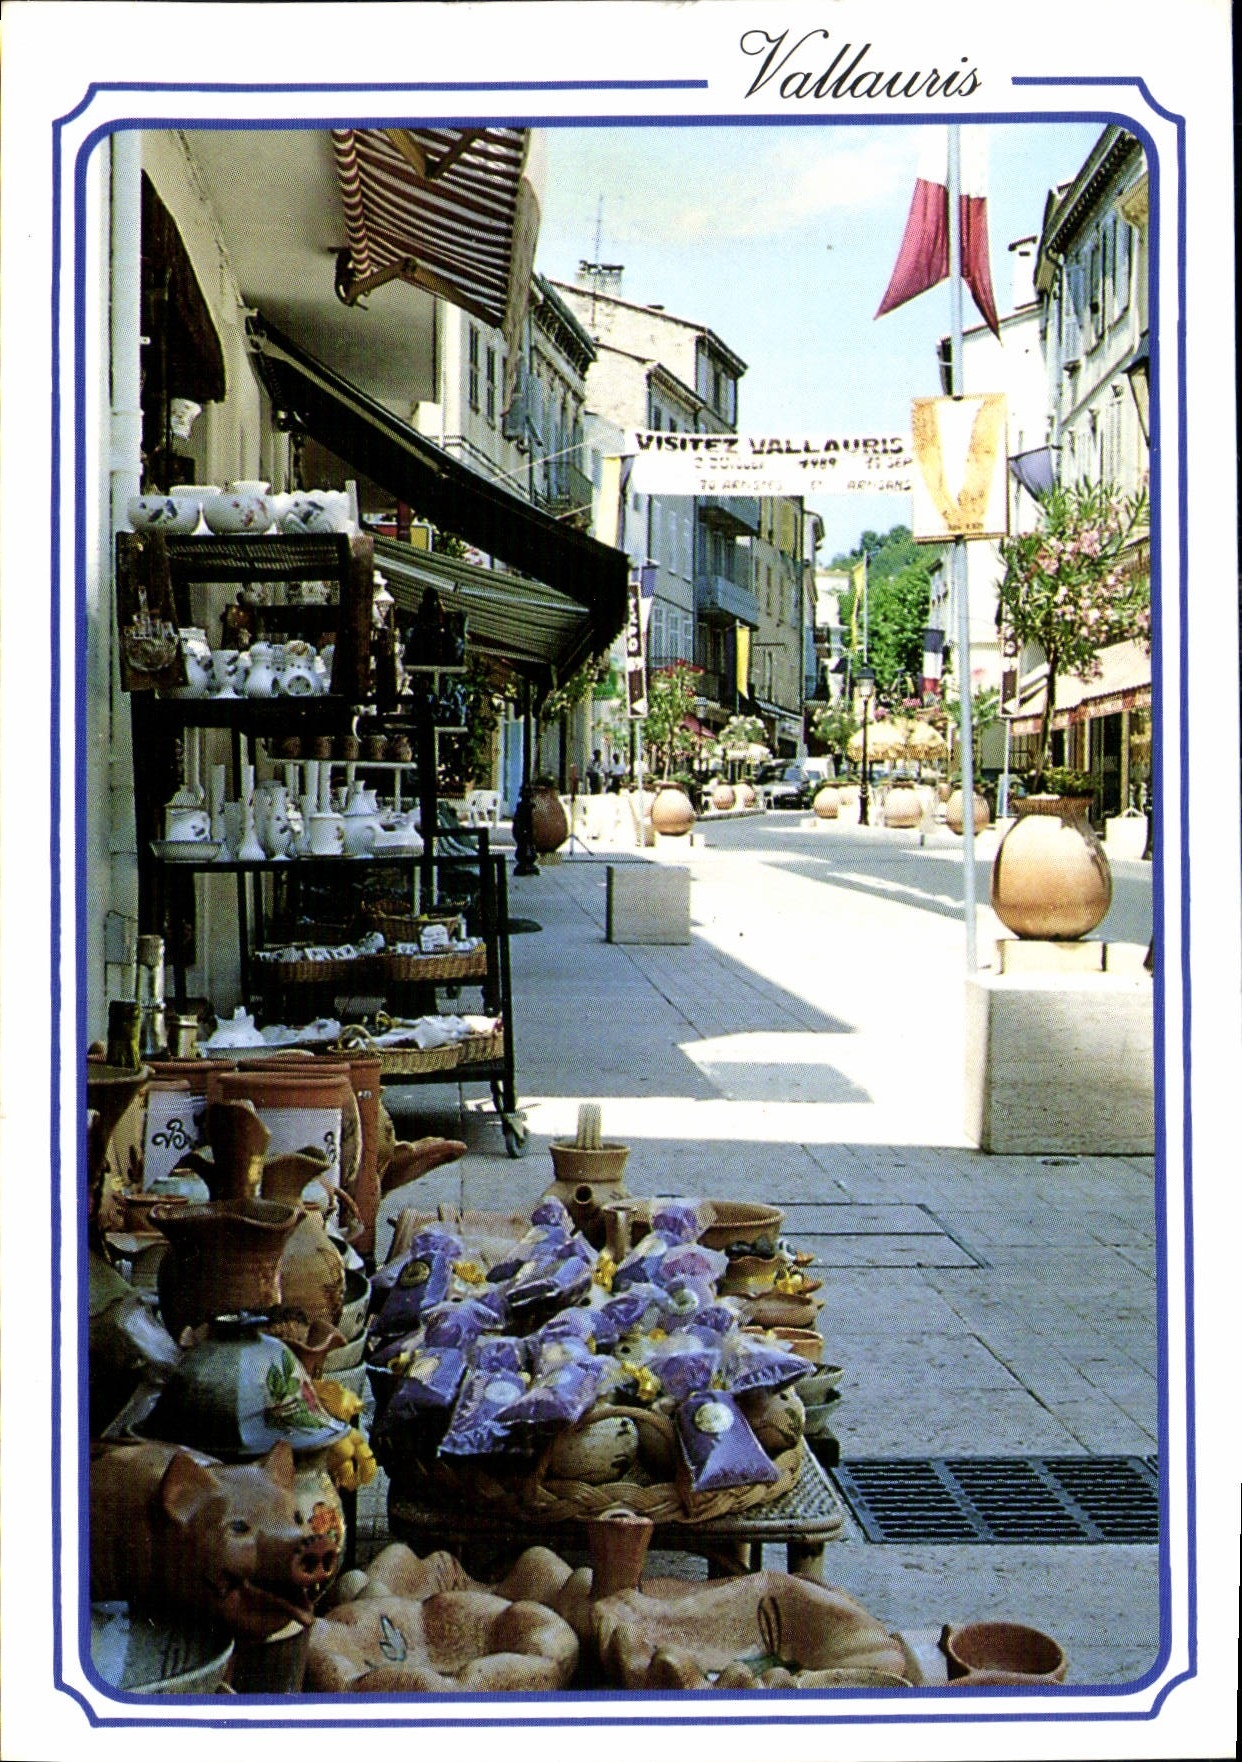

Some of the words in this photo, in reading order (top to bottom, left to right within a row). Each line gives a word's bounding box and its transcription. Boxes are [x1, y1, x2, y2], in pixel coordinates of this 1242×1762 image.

[635, 432, 739, 453] VISITEZ
[749, 437, 904, 455] VALLAURIS
[798, 457, 838, 469] 1989
